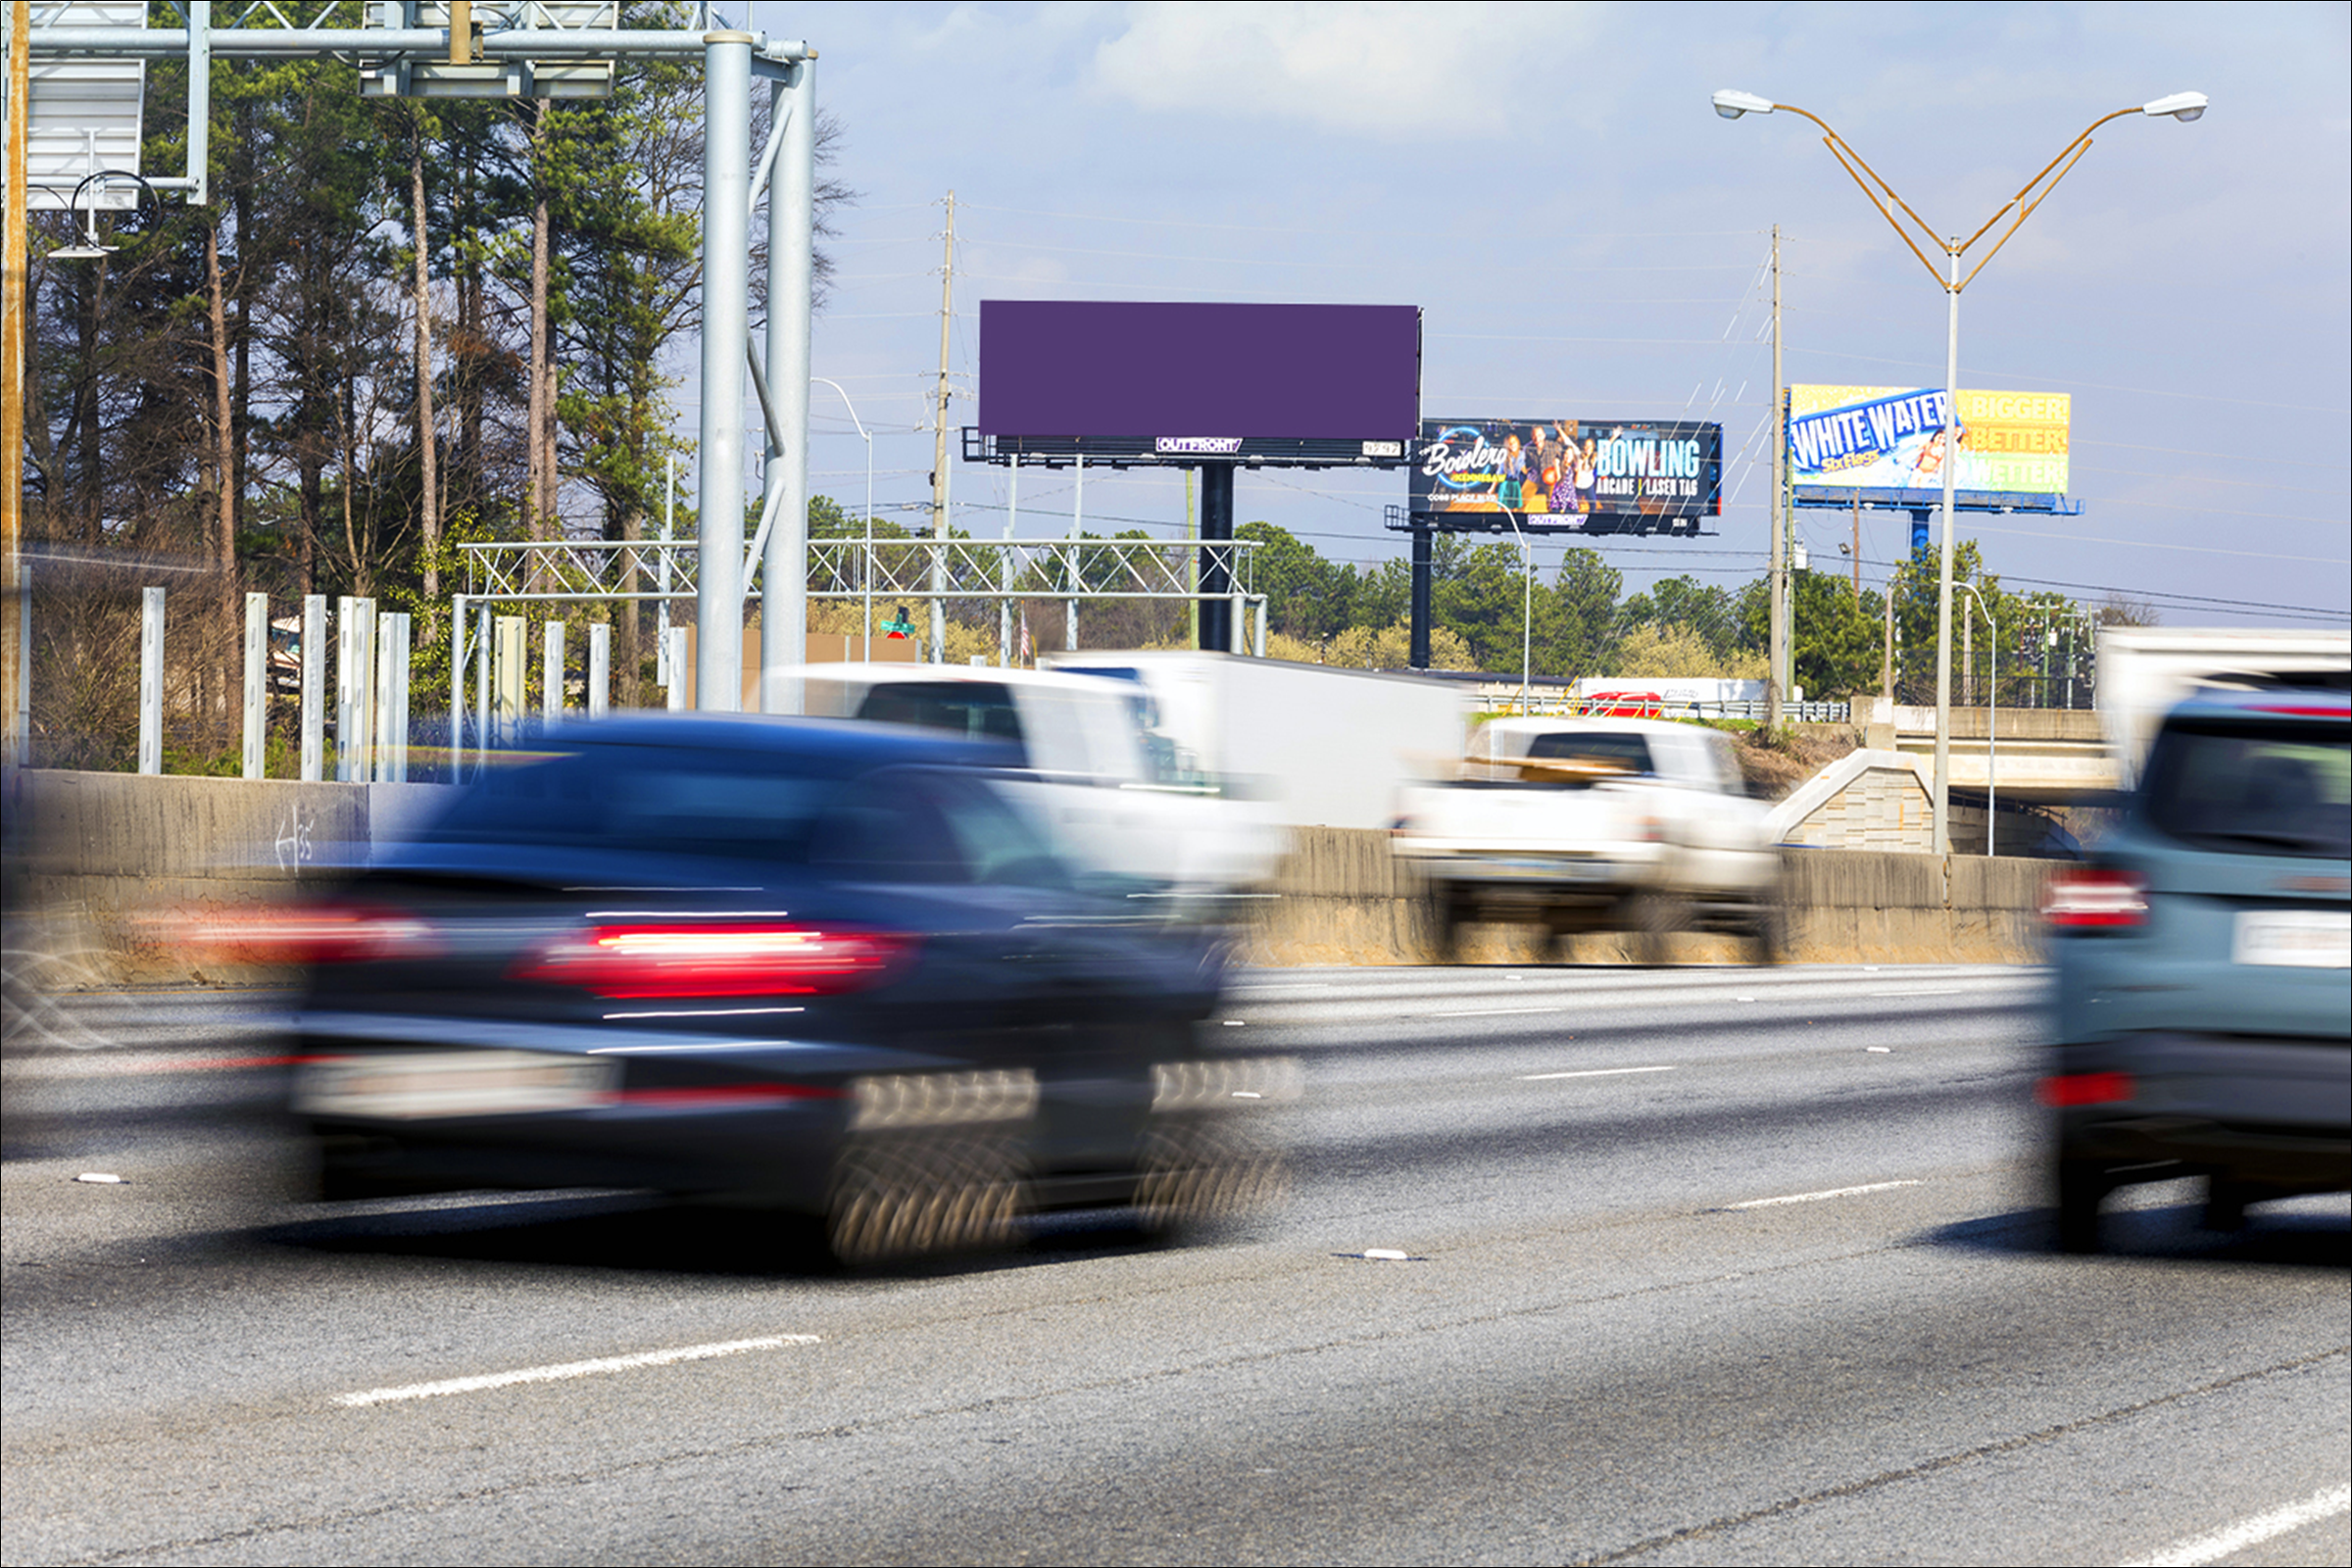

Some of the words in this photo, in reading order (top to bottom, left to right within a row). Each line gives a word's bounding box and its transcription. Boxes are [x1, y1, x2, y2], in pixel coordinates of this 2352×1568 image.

[1972, 396, 2068, 420] BIGGER!
[1789, 409, 1871, 468] WHITE
[1867, 391, 1947, 451] WATER
[1972, 427, 2068, 451] BETTER!
[1419, 435, 1508, 476] Bowlero
[1596, 439, 1700, 477] BOWLING
[1821, 457, 1844, 472] Six
[1843, 448, 1880, 467] Flags
[1595, 477, 1635, 495] ARCADE
[1645, 477, 1677, 496] LASER
[1679, 478, 1698, 496] TAG
